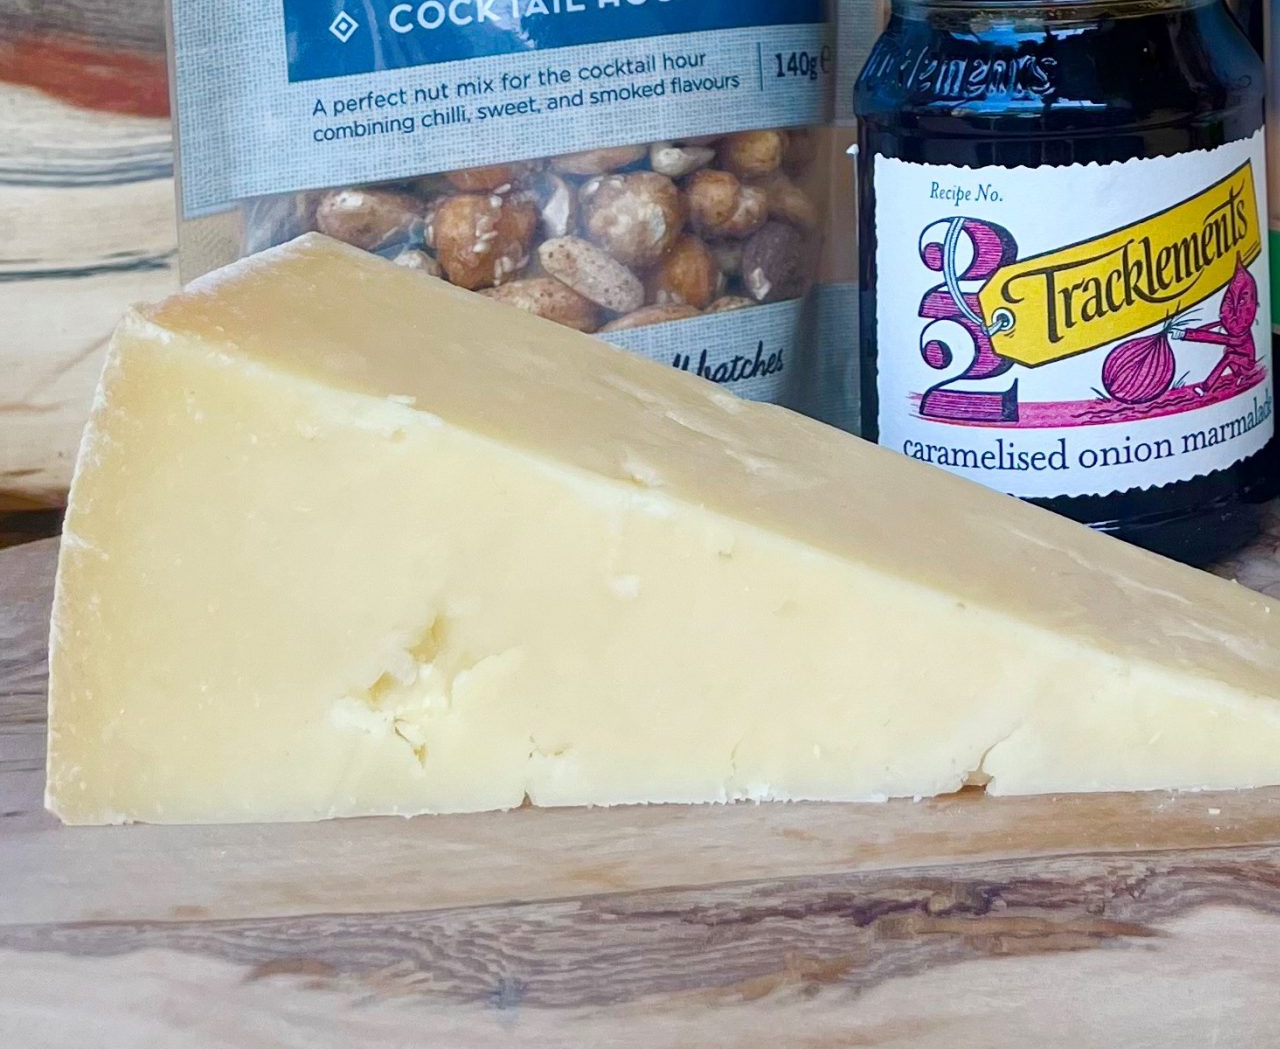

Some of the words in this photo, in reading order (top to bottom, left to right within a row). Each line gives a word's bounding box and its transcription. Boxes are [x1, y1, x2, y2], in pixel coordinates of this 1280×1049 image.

[312, 98, 327, 117] A
[333, 88, 407, 117] perfect
[414, 83, 449, 103] nut
[457, 77, 494, 97] mix
[502, 72, 531, 91] for
[538, 68, 571, 86] the
[578, 54, 656, 81] cocktail
[663, 53, 707, 70] hour
[313, 116, 415, 142] combining
[421, 105, 471, 128] chilli,
[477, 96, 542, 120] sweet,
[547, 90, 584, 110] and
[590, 79, 665, 105] smoked
[670, 74, 741, 95] flavours
[930, 181, 972, 207] Recipe
[975, 183, 1004, 202] No.
[1002, 177, 1249, 344] Tracklements
[696, 340, 785, 383] batches
[903, 437, 1070, 471] caramelised
[1078, 431, 1174, 467] onion
